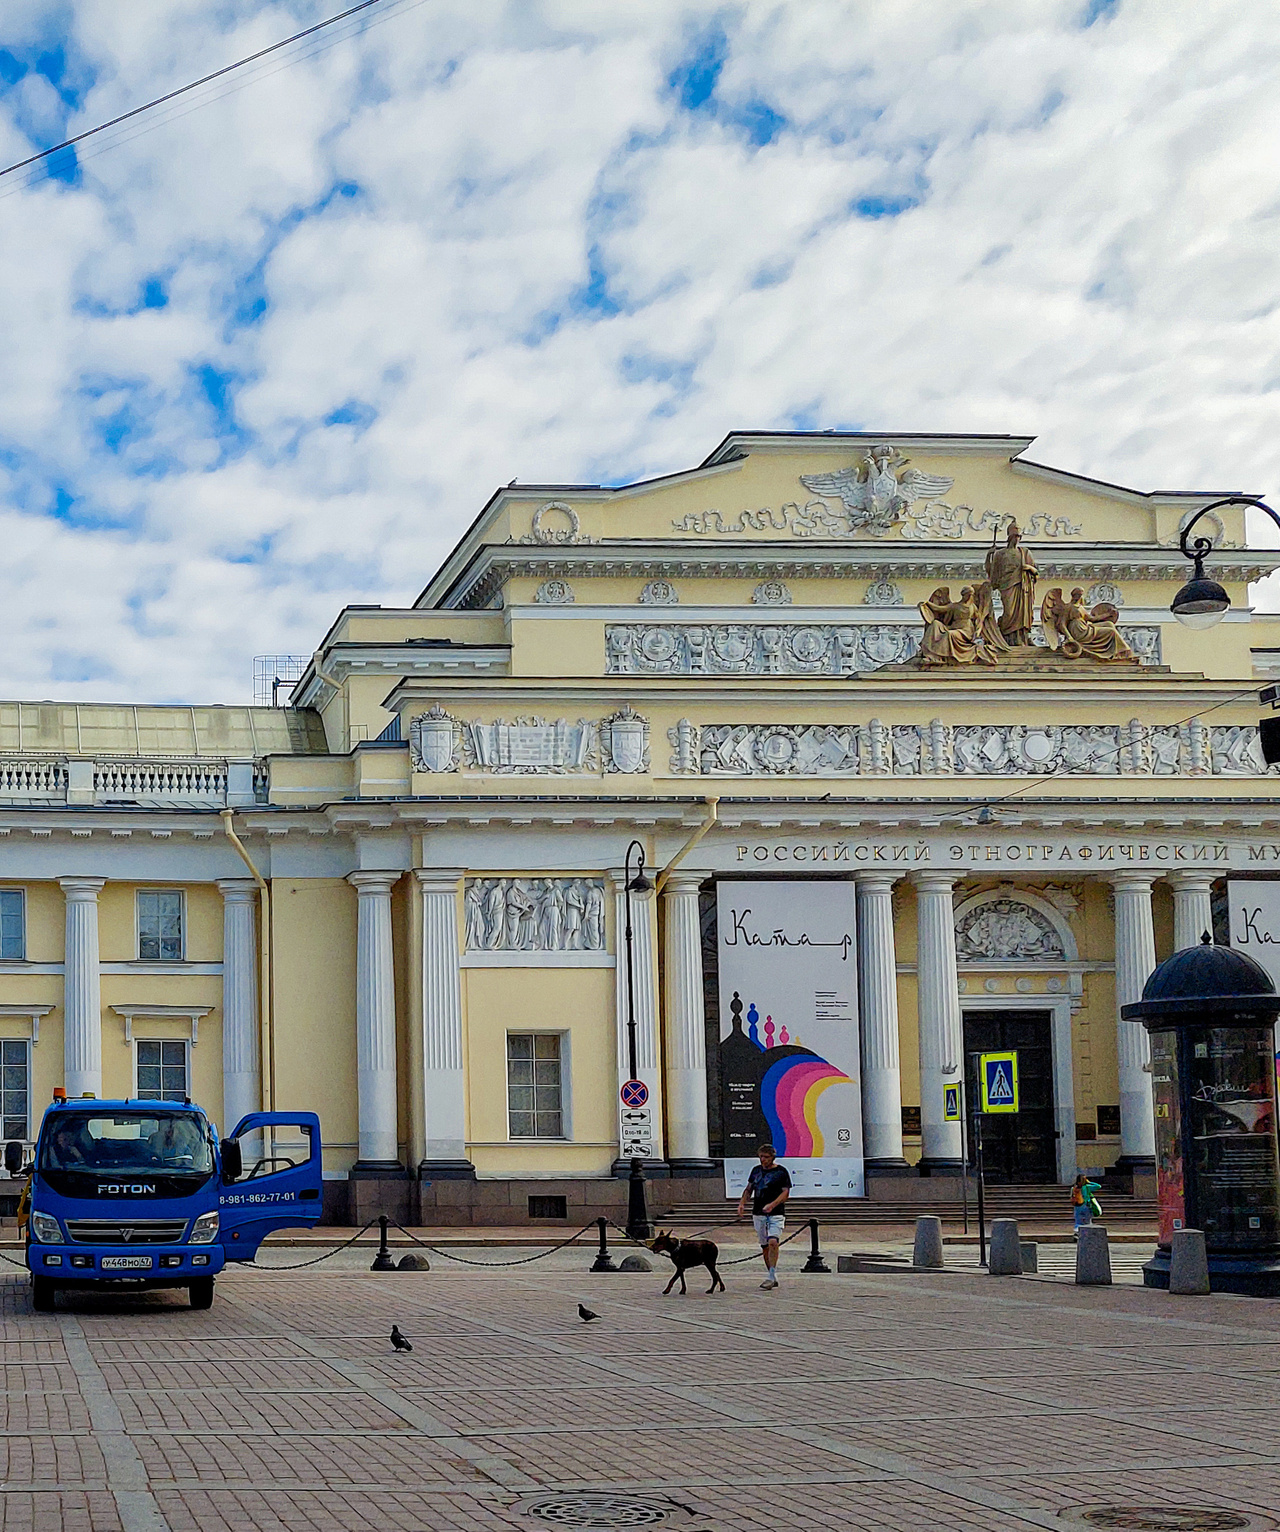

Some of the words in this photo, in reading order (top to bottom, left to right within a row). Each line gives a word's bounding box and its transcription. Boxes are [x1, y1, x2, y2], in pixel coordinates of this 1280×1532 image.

[736, 841, 931, 861] РОССИЙСКИЙ
[949, 841, 1230, 861] ЭТНОГРАФИЧЕСКИЙ
[724, 909, 852, 961] Катар
[97, 1184, 156, 1194] FOTON
[219, 1192, 295, 1205] 8-981-862-77-01
